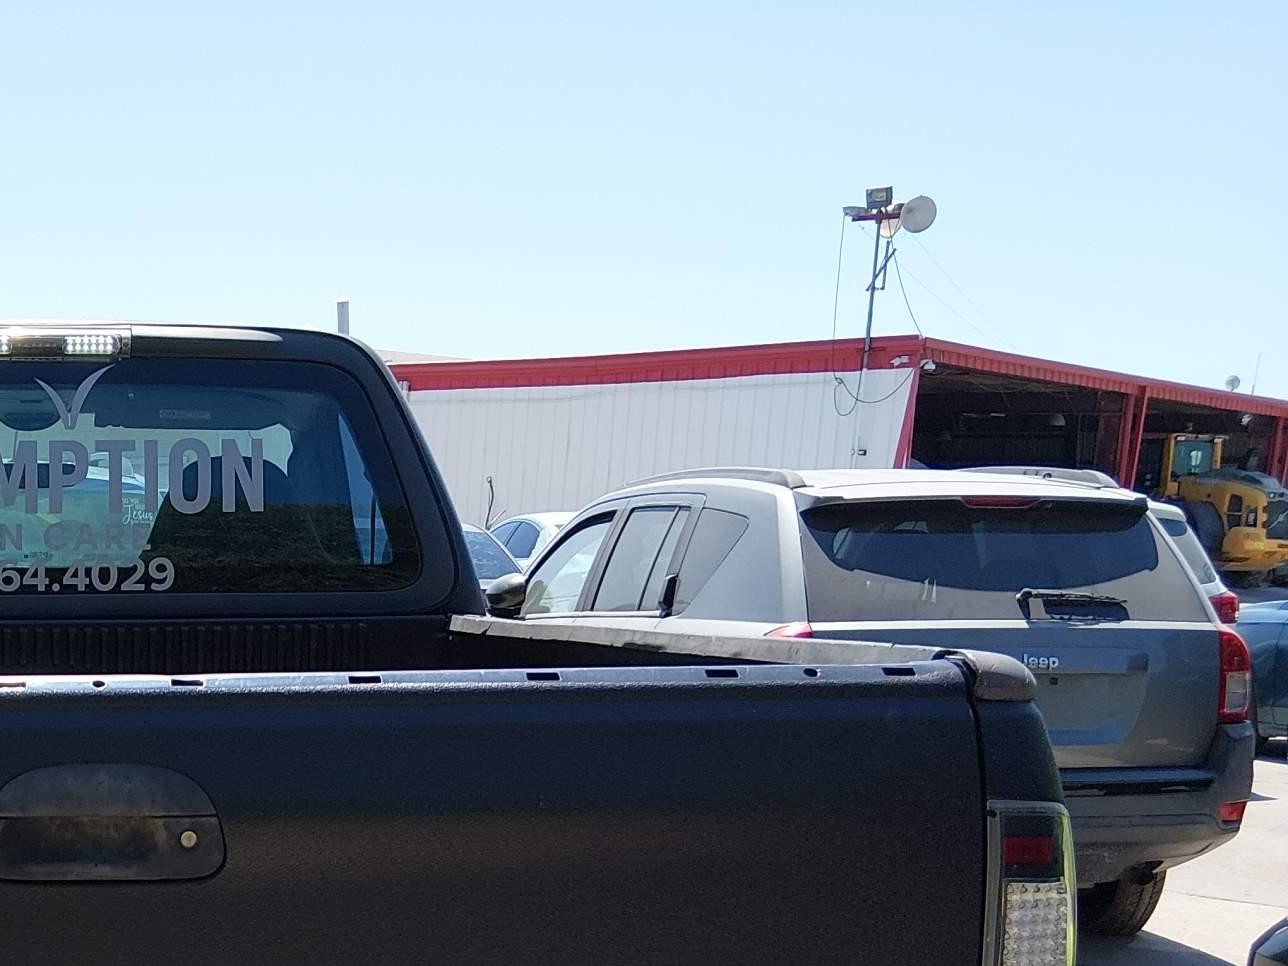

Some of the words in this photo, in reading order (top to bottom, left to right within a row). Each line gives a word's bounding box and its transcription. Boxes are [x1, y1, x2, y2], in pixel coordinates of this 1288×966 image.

[122, 504, 153, 525] Jesus
[43, 520, 152, 550] CARE
[1023, 653, 1059, 671] Jeep
